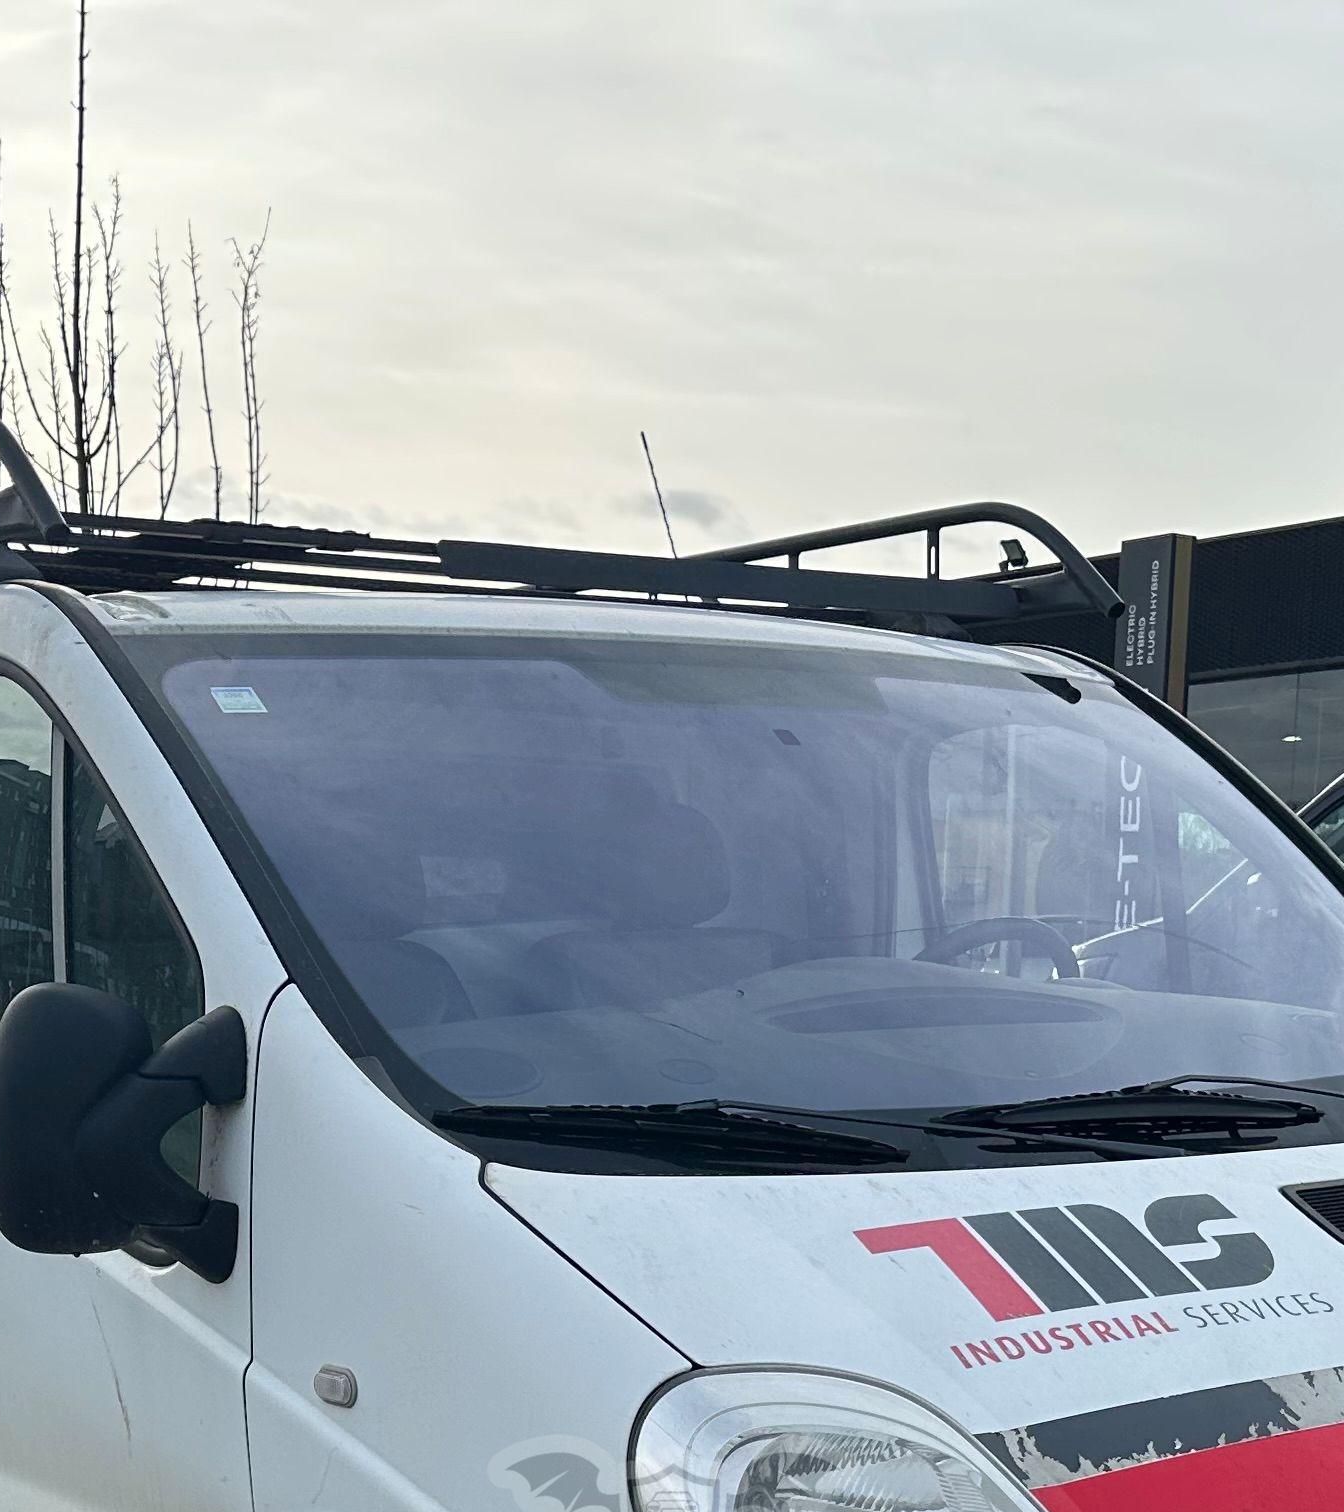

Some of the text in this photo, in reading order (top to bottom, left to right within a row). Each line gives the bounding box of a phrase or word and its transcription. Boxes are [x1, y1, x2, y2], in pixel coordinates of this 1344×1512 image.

[1150, 560, 1160, 609] HYBRID
[1137, 617, 1146, 666] HYBRID
[852, 1193, 1275, 1322] TMS
[950, 1292, 1335, 1369] INDUSTRIAL SERVICES
